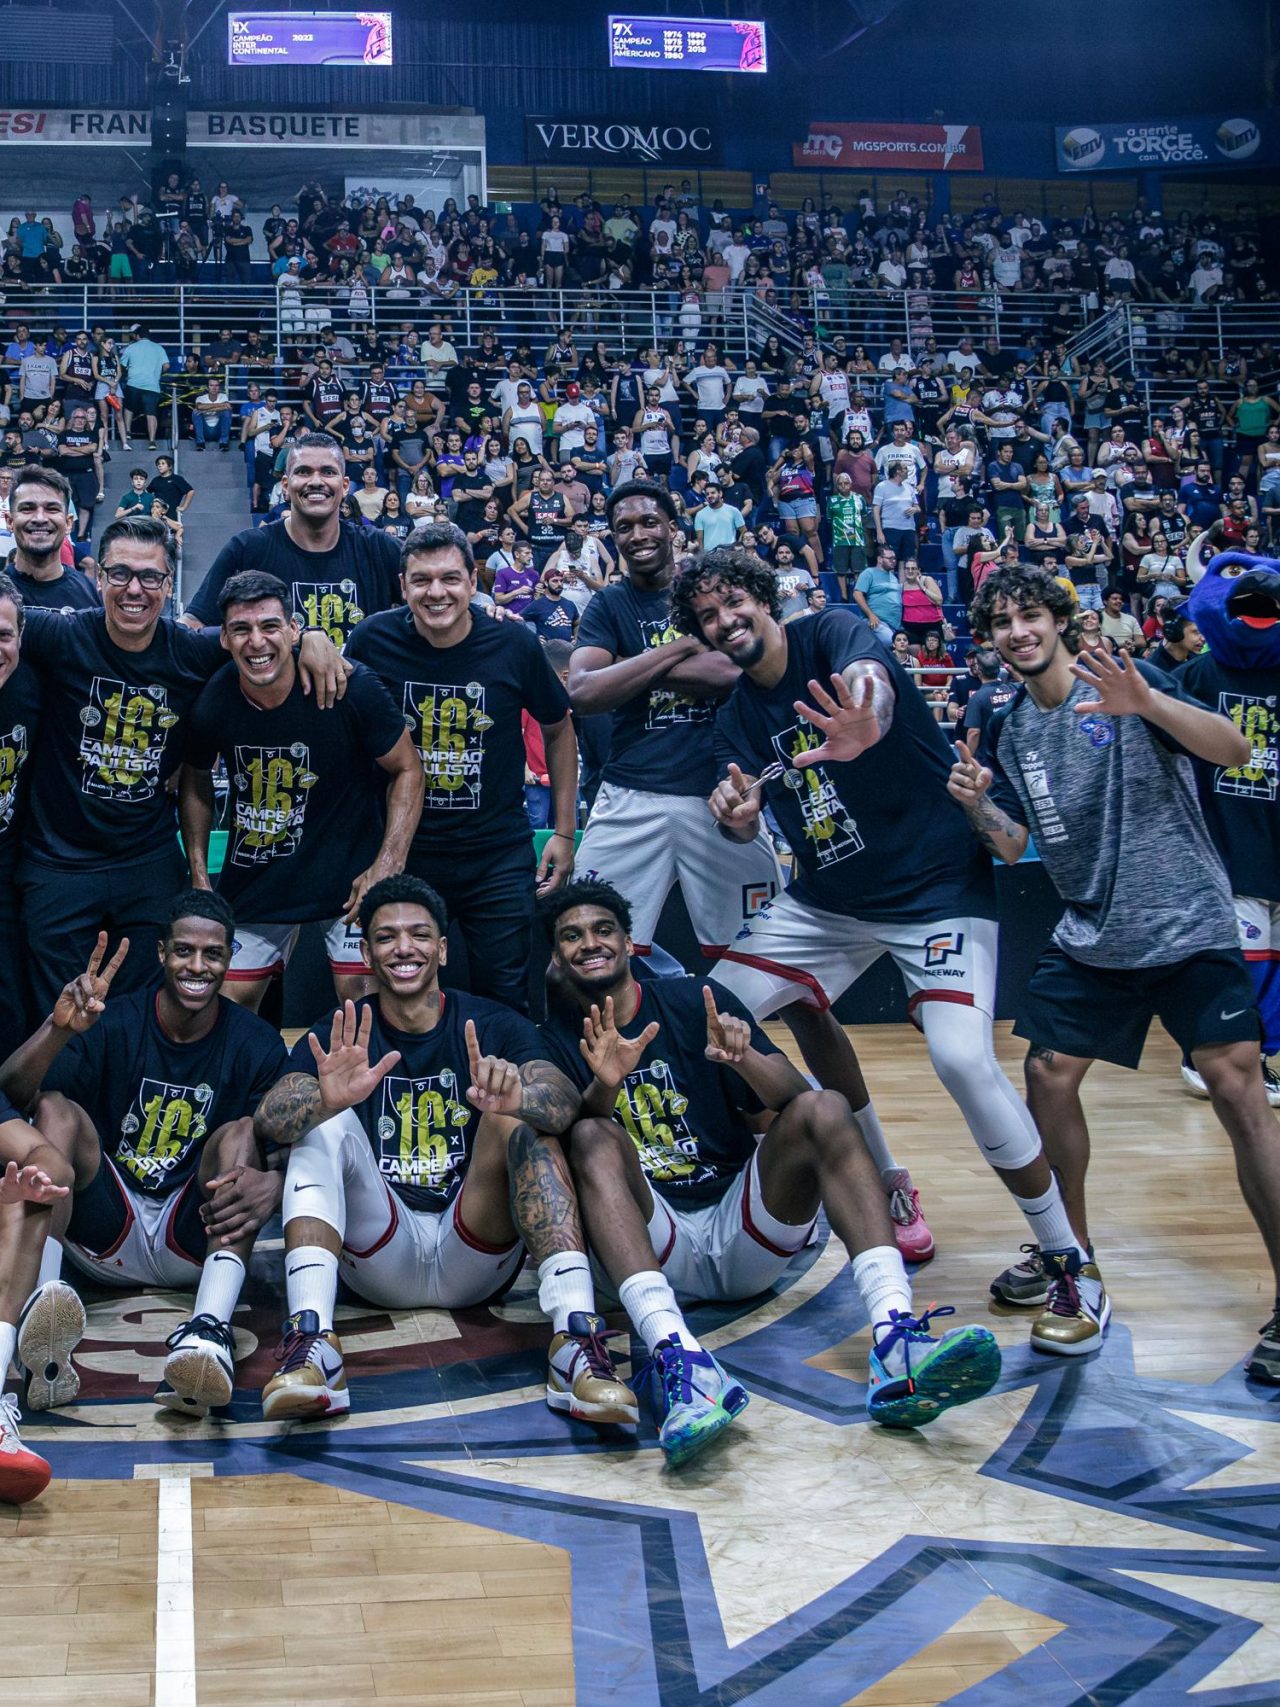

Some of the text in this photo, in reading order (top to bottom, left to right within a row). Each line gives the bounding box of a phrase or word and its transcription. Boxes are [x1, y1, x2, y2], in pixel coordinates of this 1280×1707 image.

[232, 22, 250, 33] 1X
[612, 23, 633, 36] 7X
[232, 34, 273, 42] CAMPEÃO
[613, 36, 652, 45] CAMPEÃO
[232, 47, 288, 55] CONTINENTAL
[613, 50, 661, 58] AMERICANO
[70, 113, 150, 134] FRAN
[207, 114, 360, 140] BASQUETE
[1127, 125, 1178, 138] a gente
[535, 123, 712, 155] VEROMOC
[1113, 133, 1193, 154] TORCE
[1138, 154, 1159, 162] com
[541, 525, 554, 534] 32
[992, 694, 1012, 704] SESI
[80, 750, 160, 772] PAULISTA
[417, 750, 483, 763] AMPEÃO
[424, 763, 480, 776] ULISTA
